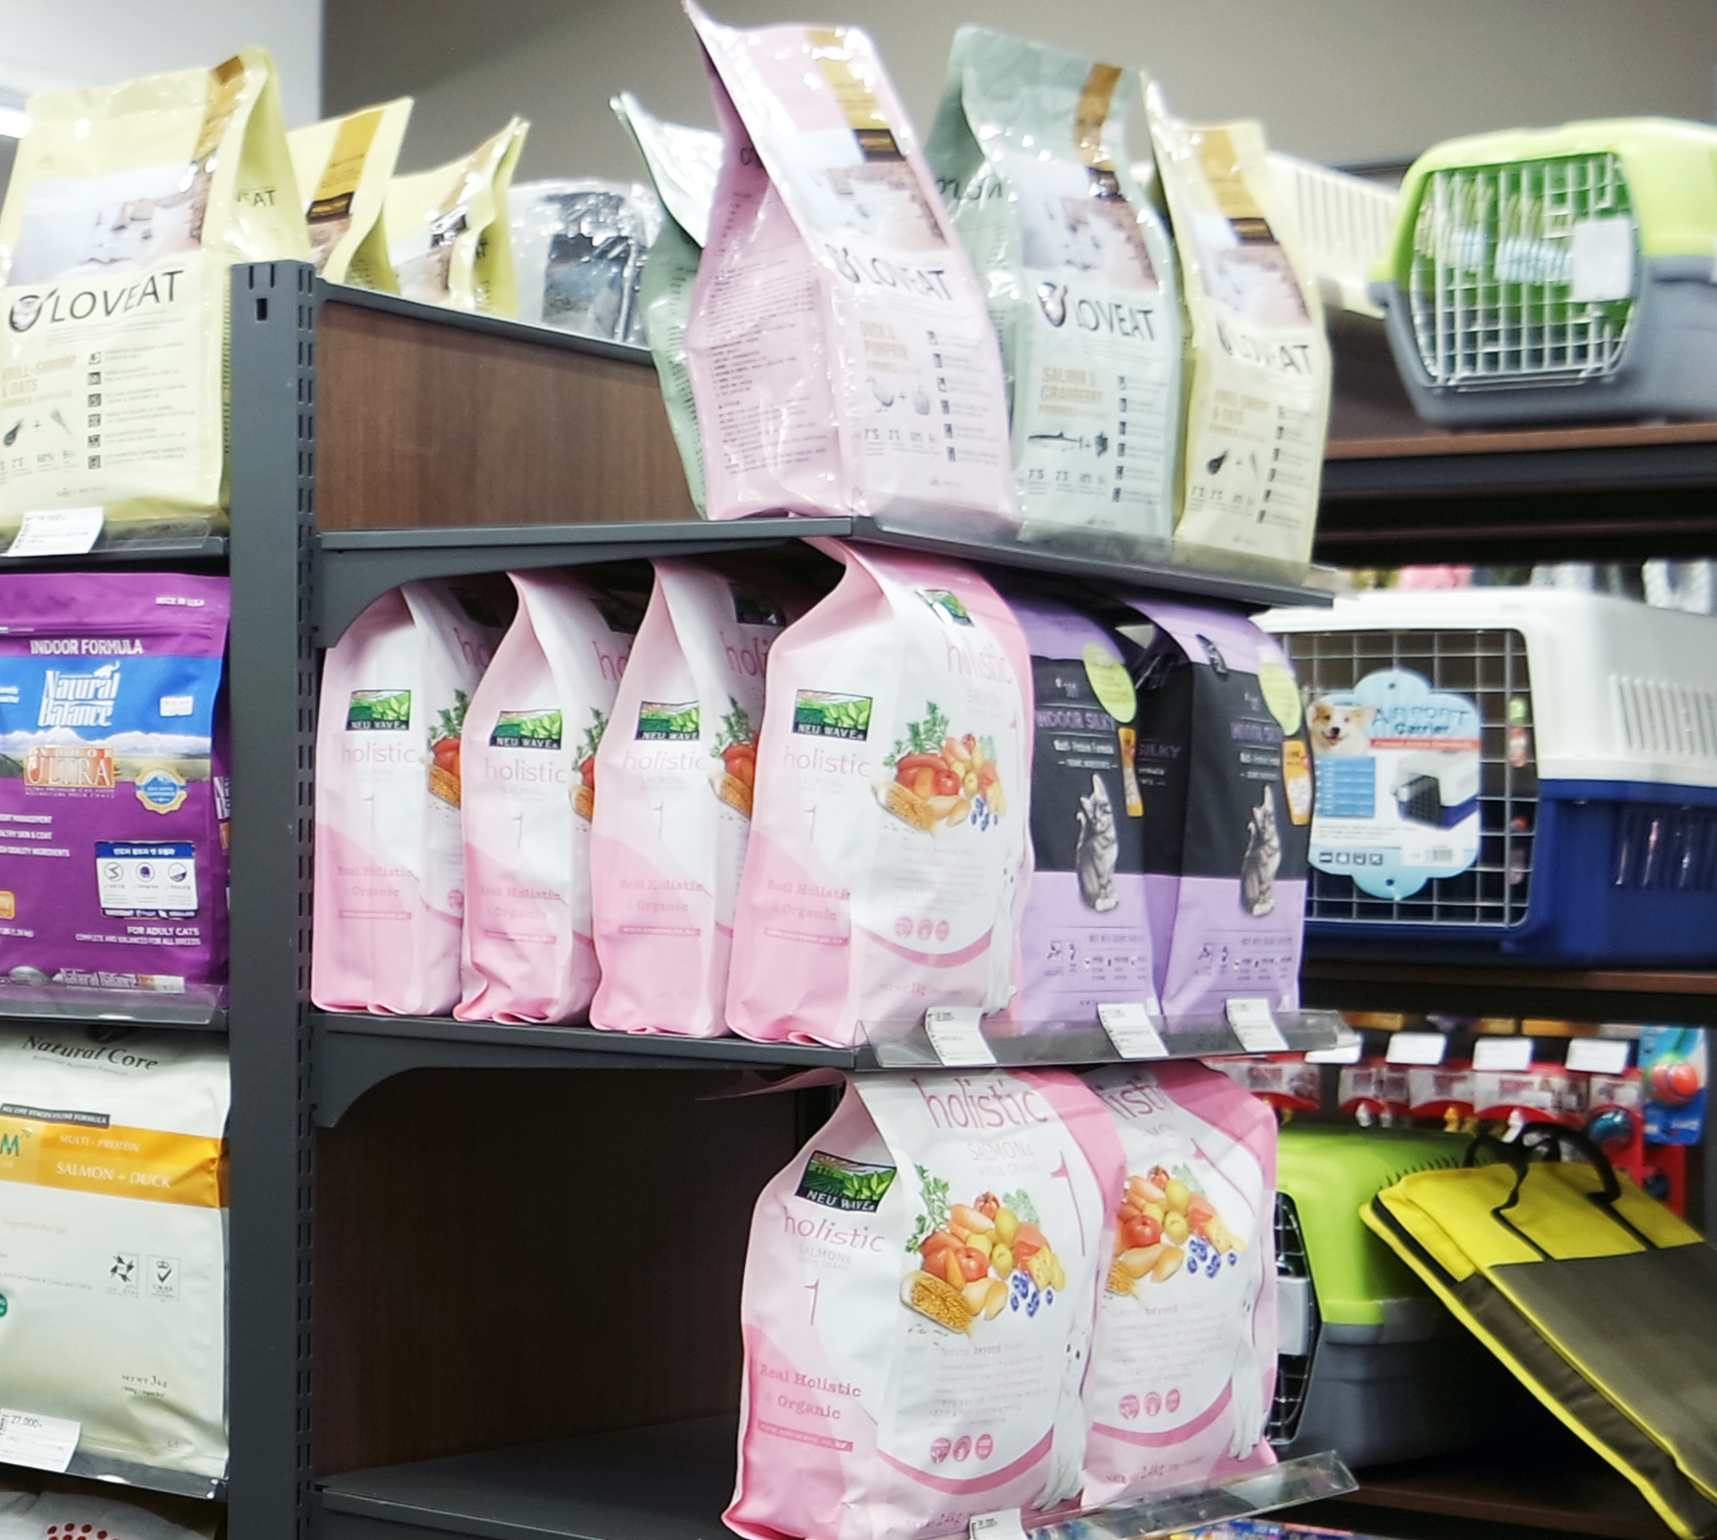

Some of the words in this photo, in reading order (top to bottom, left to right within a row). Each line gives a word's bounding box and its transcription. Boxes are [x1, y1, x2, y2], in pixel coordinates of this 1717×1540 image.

[49, 269, 185, 326] LOVEAT
[30, 640, 79, 654] INDOOR
[81, 640, 144, 654] FORMULA
[44, 670, 121, 699] Natural
[38, 698, 114, 727] Balance
[351, 721, 371, 729] NEU
[373, 721, 401, 729] WAVE
[496, 738, 518, 746] NEU
[520, 738, 552, 748] WAVE
[798, 725, 820, 735] NEU
[823, 726, 856, 739] WAVE
[341, 743, 415, 764] holistic
[782, 746, 871, 778] holistic
[26, 759, 113, 786] ULTRA
[484, 758, 567, 784] holistic
[127, 926, 145, 934] FOR
[146, 927, 174, 935] ADULT
[175, 927, 199, 936] CATS
[22, 1035, 104, 1060] Natural
[107, 1048, 159, 1072] Core
[911, 1078, 1048, 1131] holistic
[98, 1138, 139, 1152] PROTEIN
[56, 1162, 113, 1180] SALMON
[129, 1172, 171, 1188] DUCK
[806, 1190, 837, 1207] NEU
[840, 1199, 869, 1211] WAVE
[782, 1204, 885, 1253] holistic
[794, 1372, 861, 1398] Holistic
[777, 1394, 841, 1420] Organic
